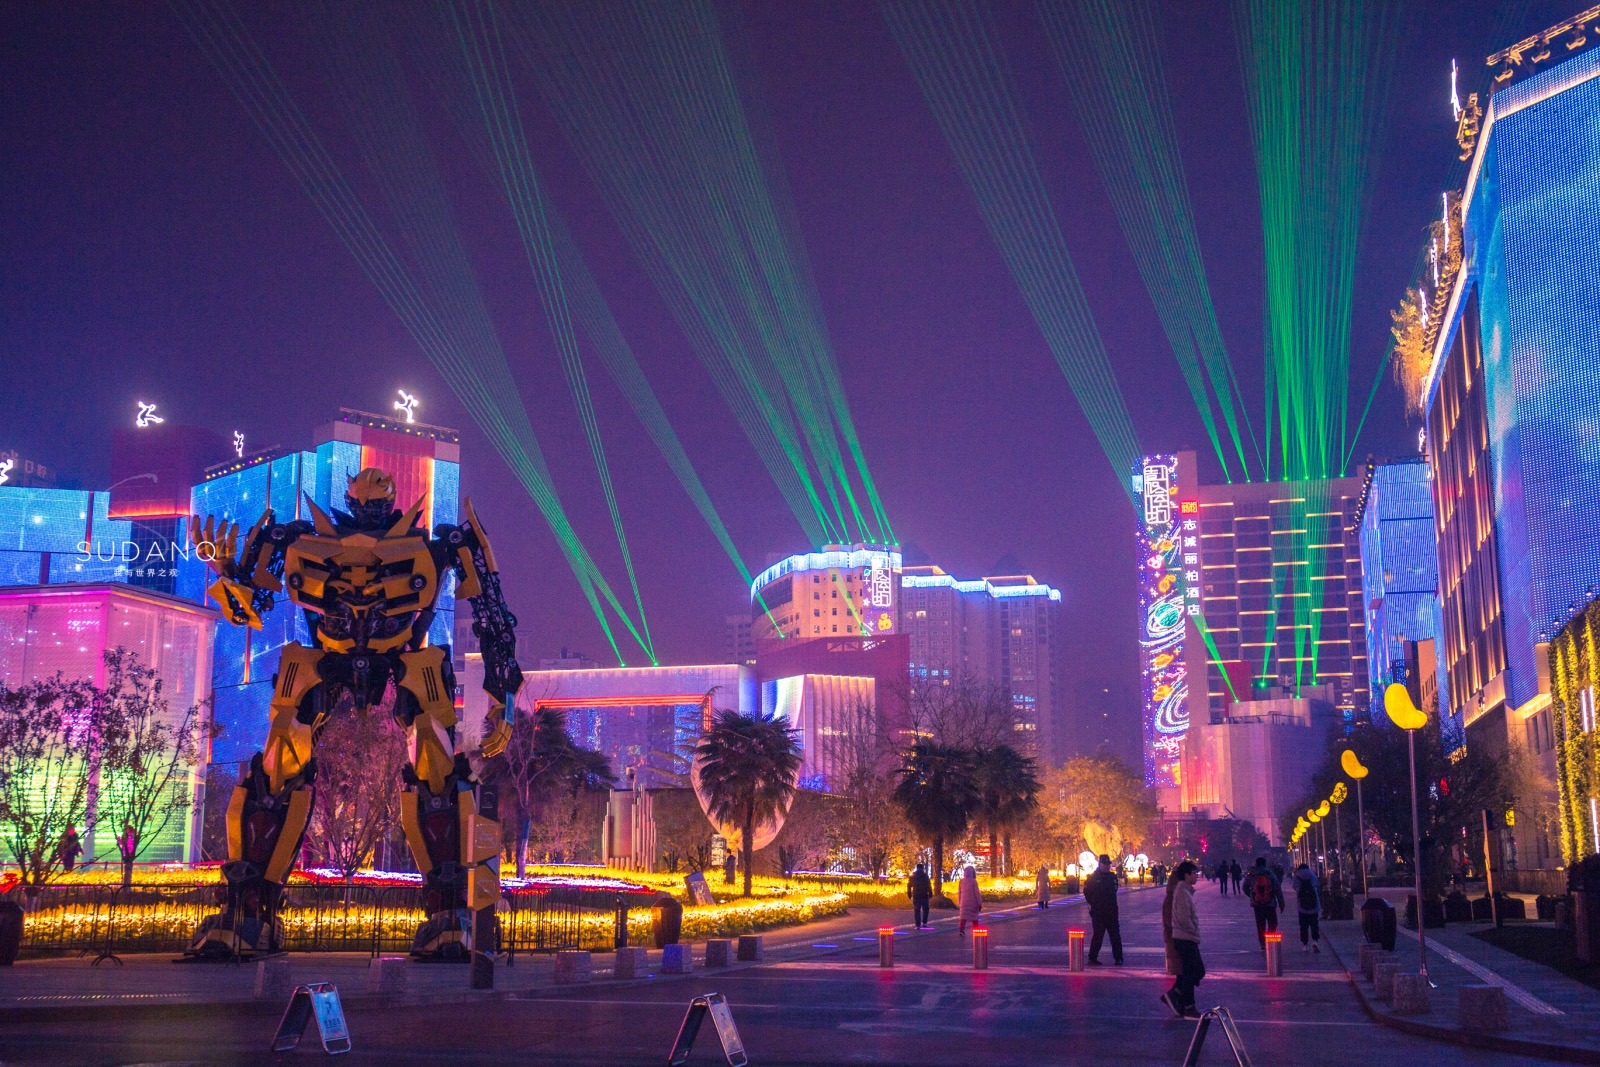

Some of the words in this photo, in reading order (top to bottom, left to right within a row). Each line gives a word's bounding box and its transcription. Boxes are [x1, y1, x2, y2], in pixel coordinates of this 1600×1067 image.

[1183, 519, 1200, 616] 志诚丽柏酒店
